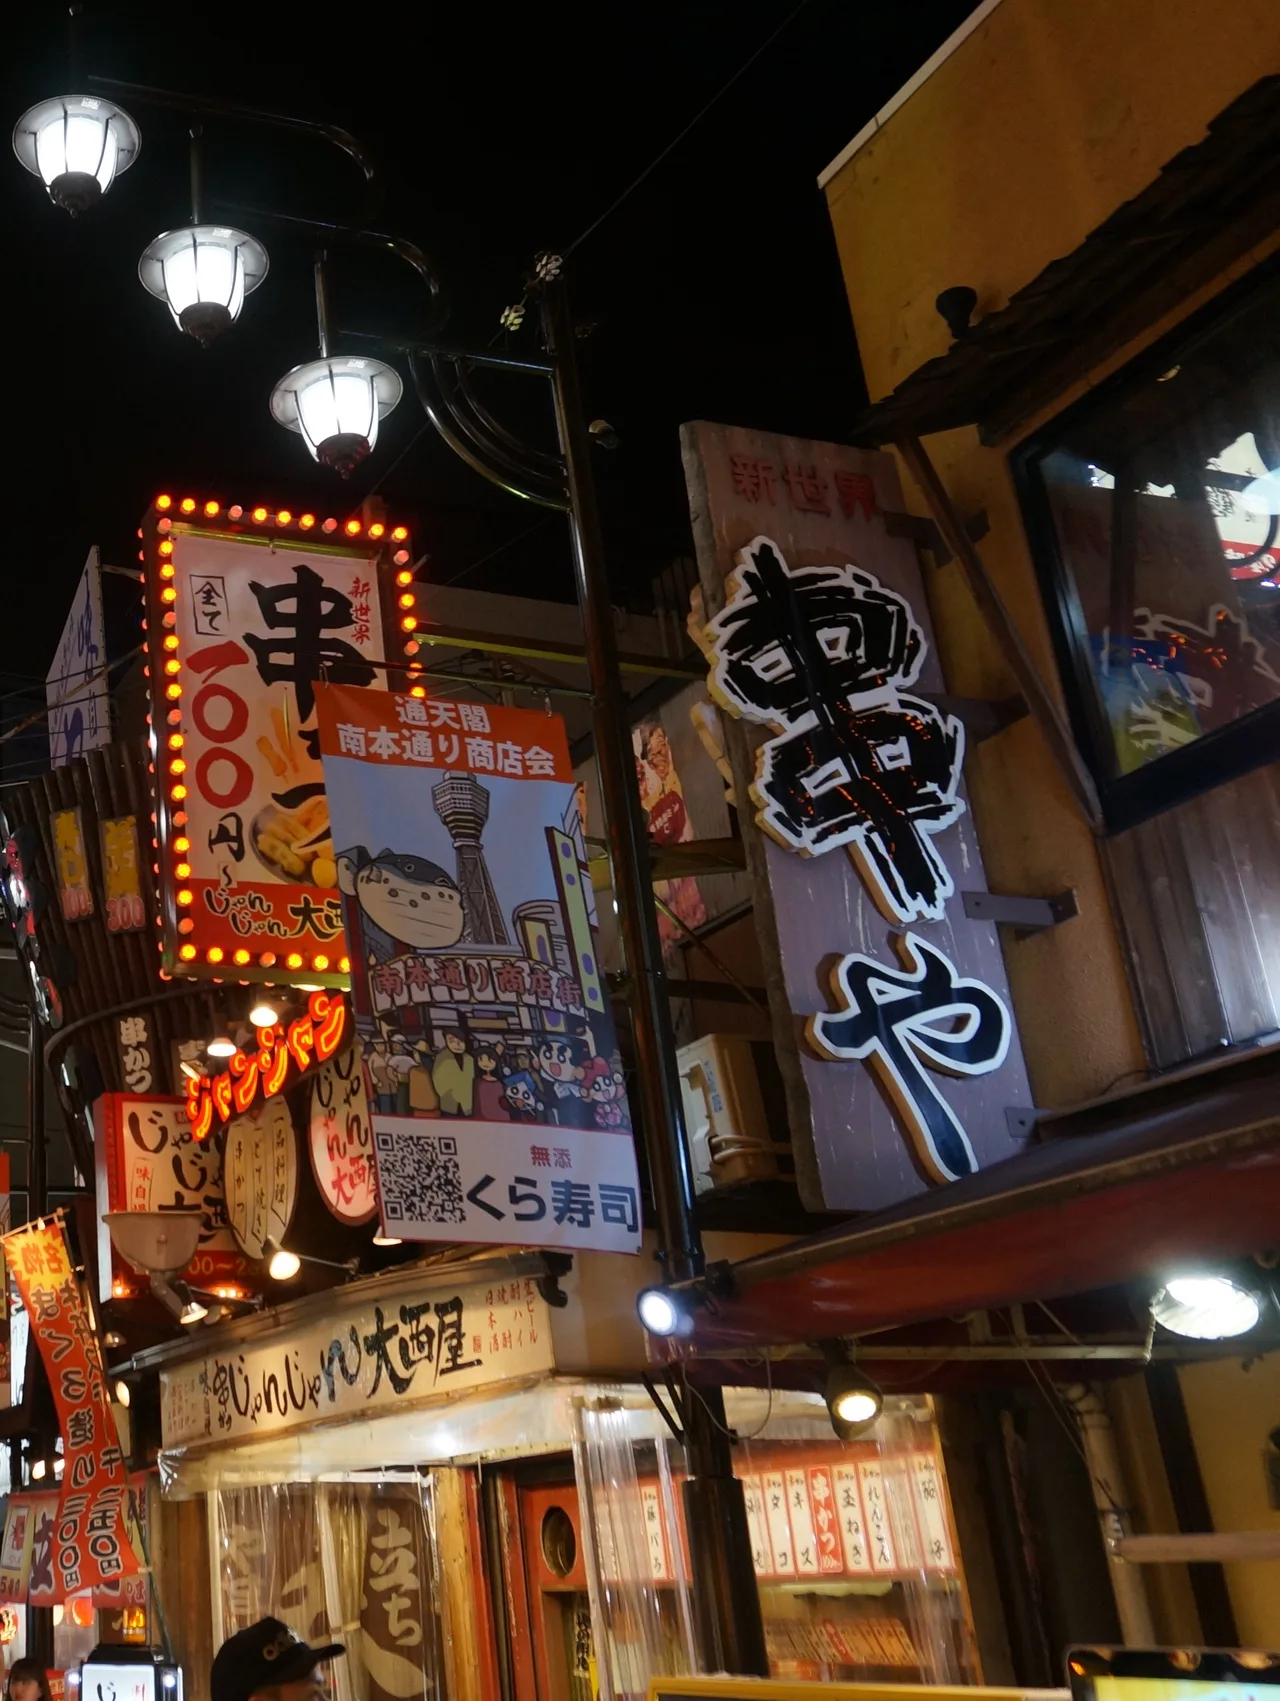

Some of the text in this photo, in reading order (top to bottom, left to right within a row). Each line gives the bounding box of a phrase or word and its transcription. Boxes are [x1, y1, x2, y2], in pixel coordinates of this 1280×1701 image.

[730, 454, 878, 523] 新世界
[194, 579, 224, 632] 全て
[349, 576, 374, 646] 新世界
[395, 697, 490, 733] 通天閣
[338, 723, 556, 777] 南本通り商店会
[374, 959, 582, 1011] 南本通り商店街
[119, 1016, 153, 1094] 串かつ
[186, 990, 345, 1143] ジャンジャン
[530, 1145, 573, 1170] 無添
[465, 1175, 639, 1234] くら寿司
[812, 1472, 836, 1555] 串かつ
